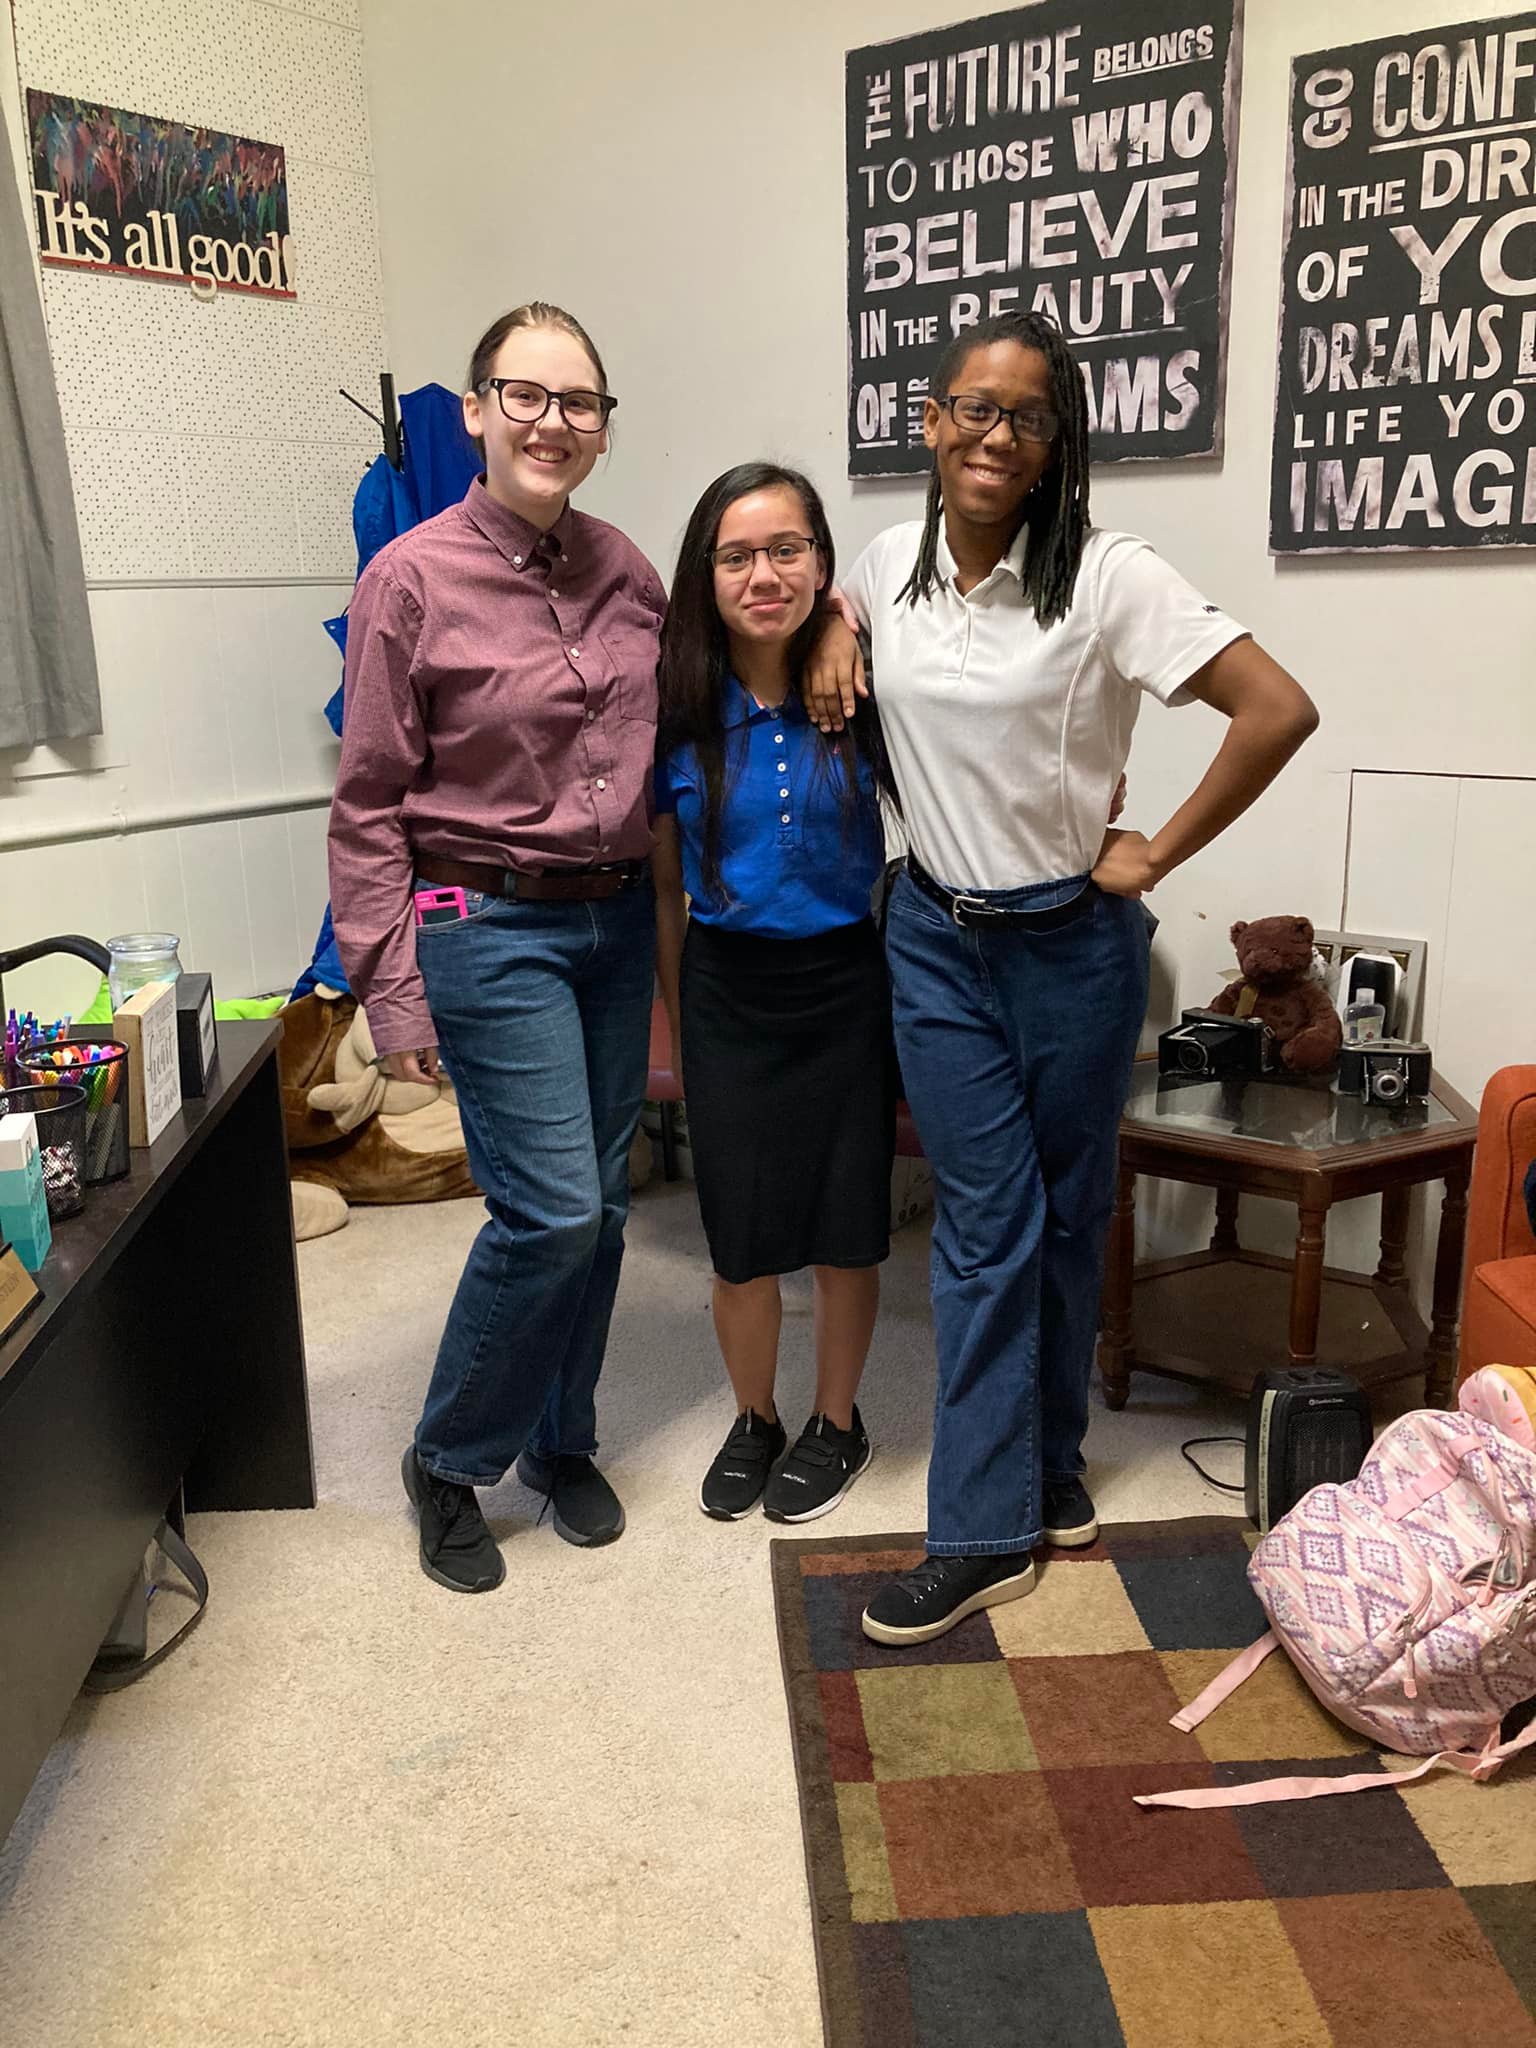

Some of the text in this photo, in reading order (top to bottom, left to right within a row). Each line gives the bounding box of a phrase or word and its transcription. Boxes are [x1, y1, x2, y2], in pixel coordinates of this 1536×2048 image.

[864, 24, 1214, 149] THE FUTURE BELONGS
[1302, 27, 1536, 150] GO CONF
[858, 91, 1214, 208] TO THOSE WHO
[1299, 137, 1536, 229] IN THE DIR
[33, 189, 111, 266] It's
[123, 210, 184, 276] all
[863, 171, 1200, 293] BELIEVE
[1297, 245, 1369, 302] OF
[859, 308, 888, 360] IN
[893, 315, 939, 347] THE
[1299, 304, 1505, 394] DREAMS
[856, 381, 898, 441] OF
[1294, 388, 1526, 449] LIFE YO
